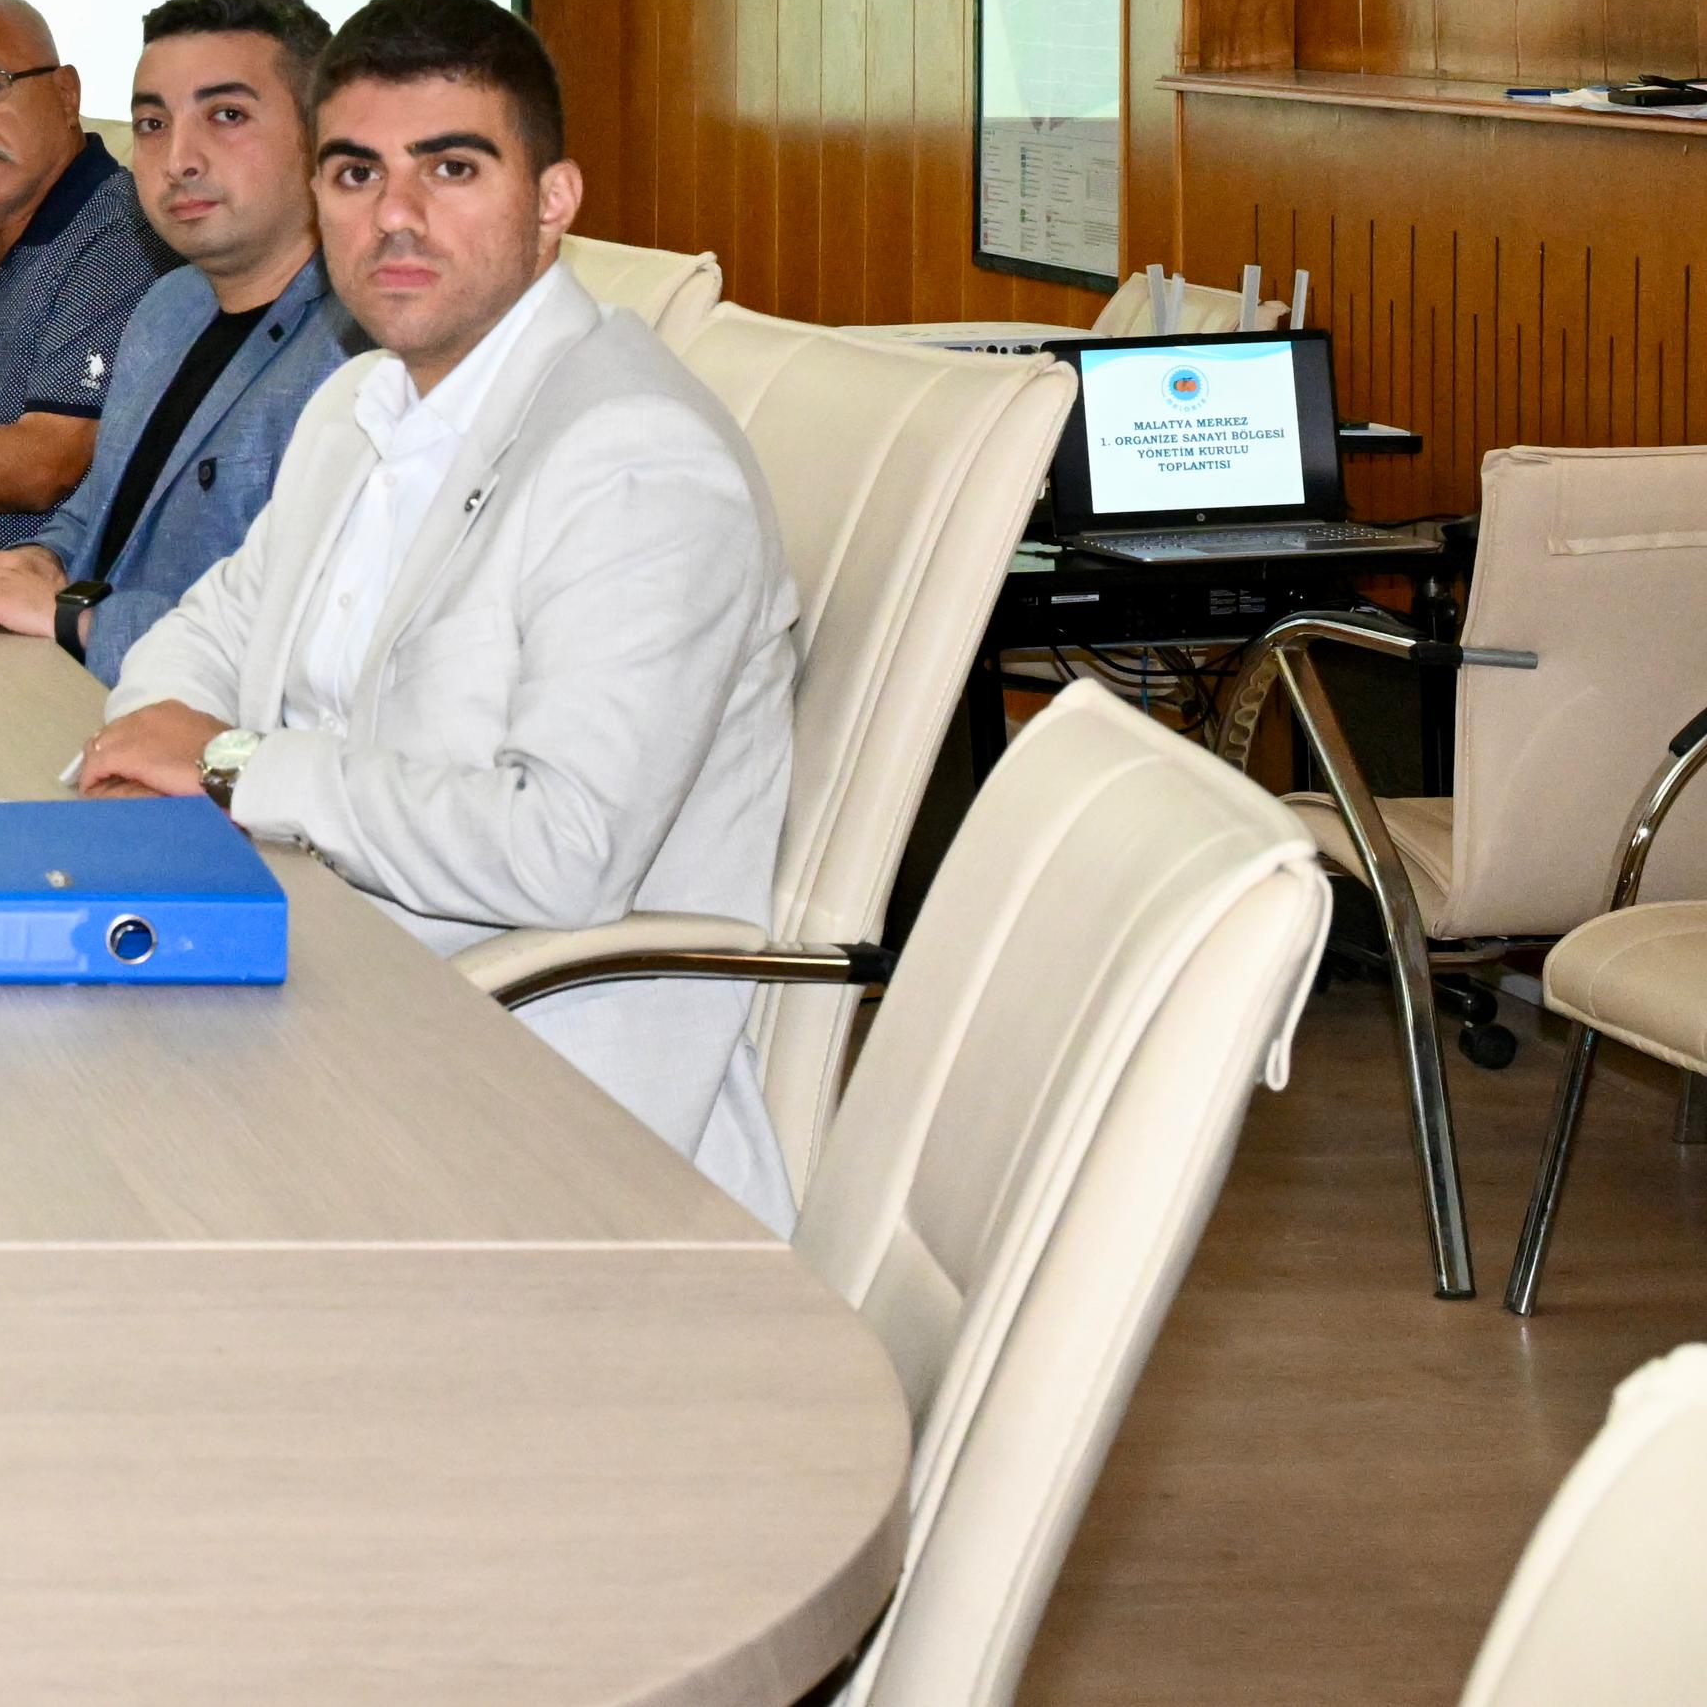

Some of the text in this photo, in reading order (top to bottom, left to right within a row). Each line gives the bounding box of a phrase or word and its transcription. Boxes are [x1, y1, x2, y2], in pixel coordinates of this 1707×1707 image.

[1134, 417, 1249, 431] MALATYA MERKEZ
[1115, 433, 1179, 446] ORGANİZE
[1231, 427, 1285, 441] BÖLGESİ
[1137, 445, 1249, 459] YÖNETİM KURULU
[1158, 460, 1231, 472] TOPLANTISI
